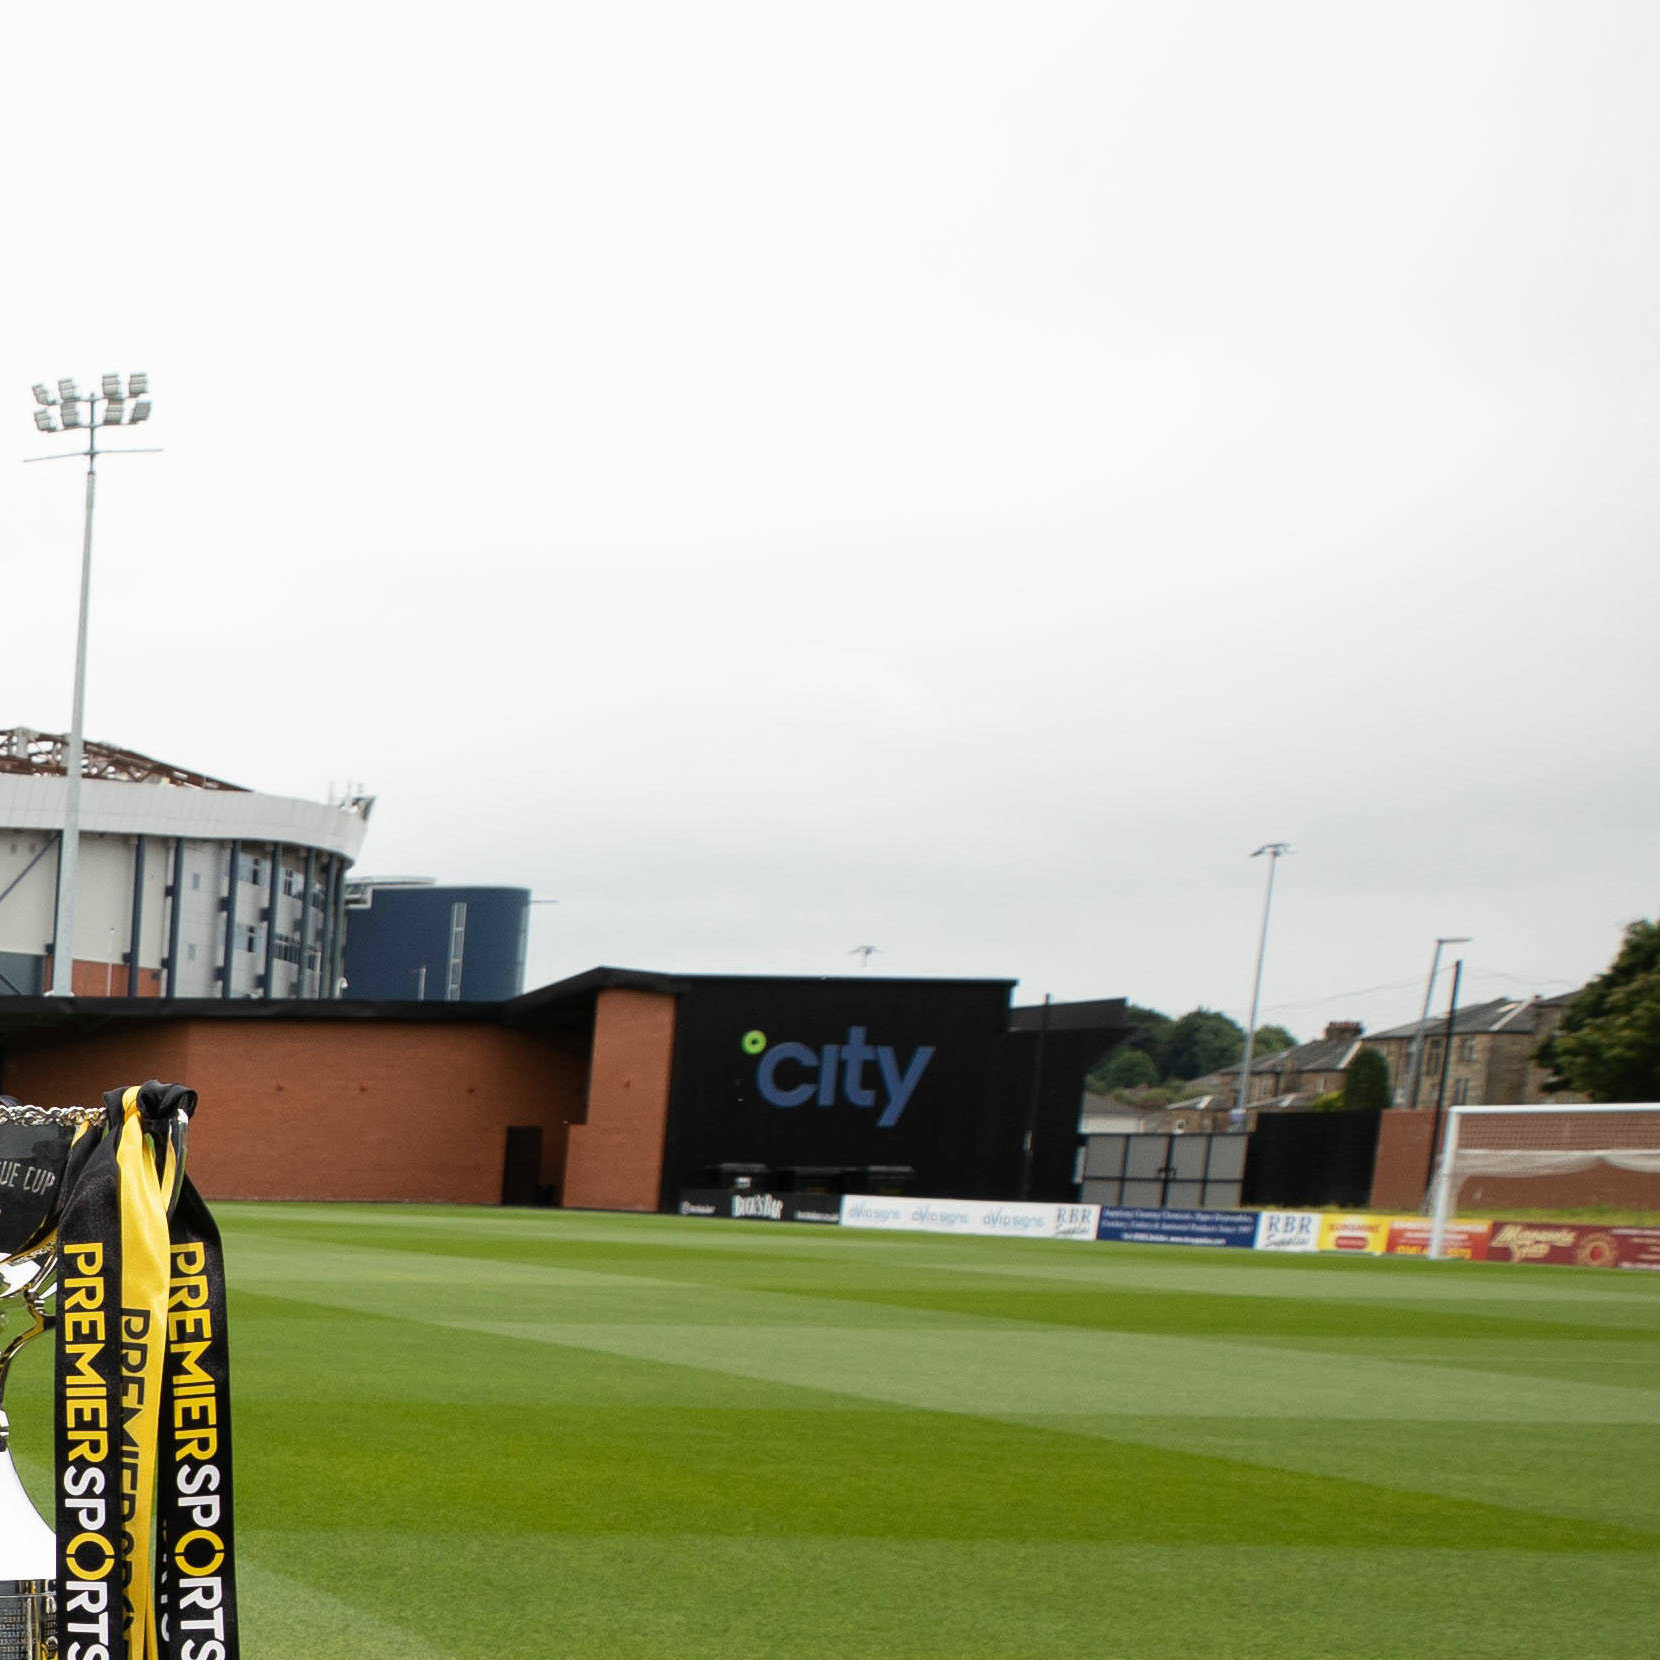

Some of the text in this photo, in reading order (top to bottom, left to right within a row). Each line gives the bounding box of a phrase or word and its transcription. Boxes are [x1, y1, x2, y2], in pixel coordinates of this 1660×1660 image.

[756, 1026, 935, 1127] city
[23, 1166, 56, 1196] CUP
[1057, 1208, 1091, 1224] RBR
[1268, 1215, 1313, 1233] RBR
